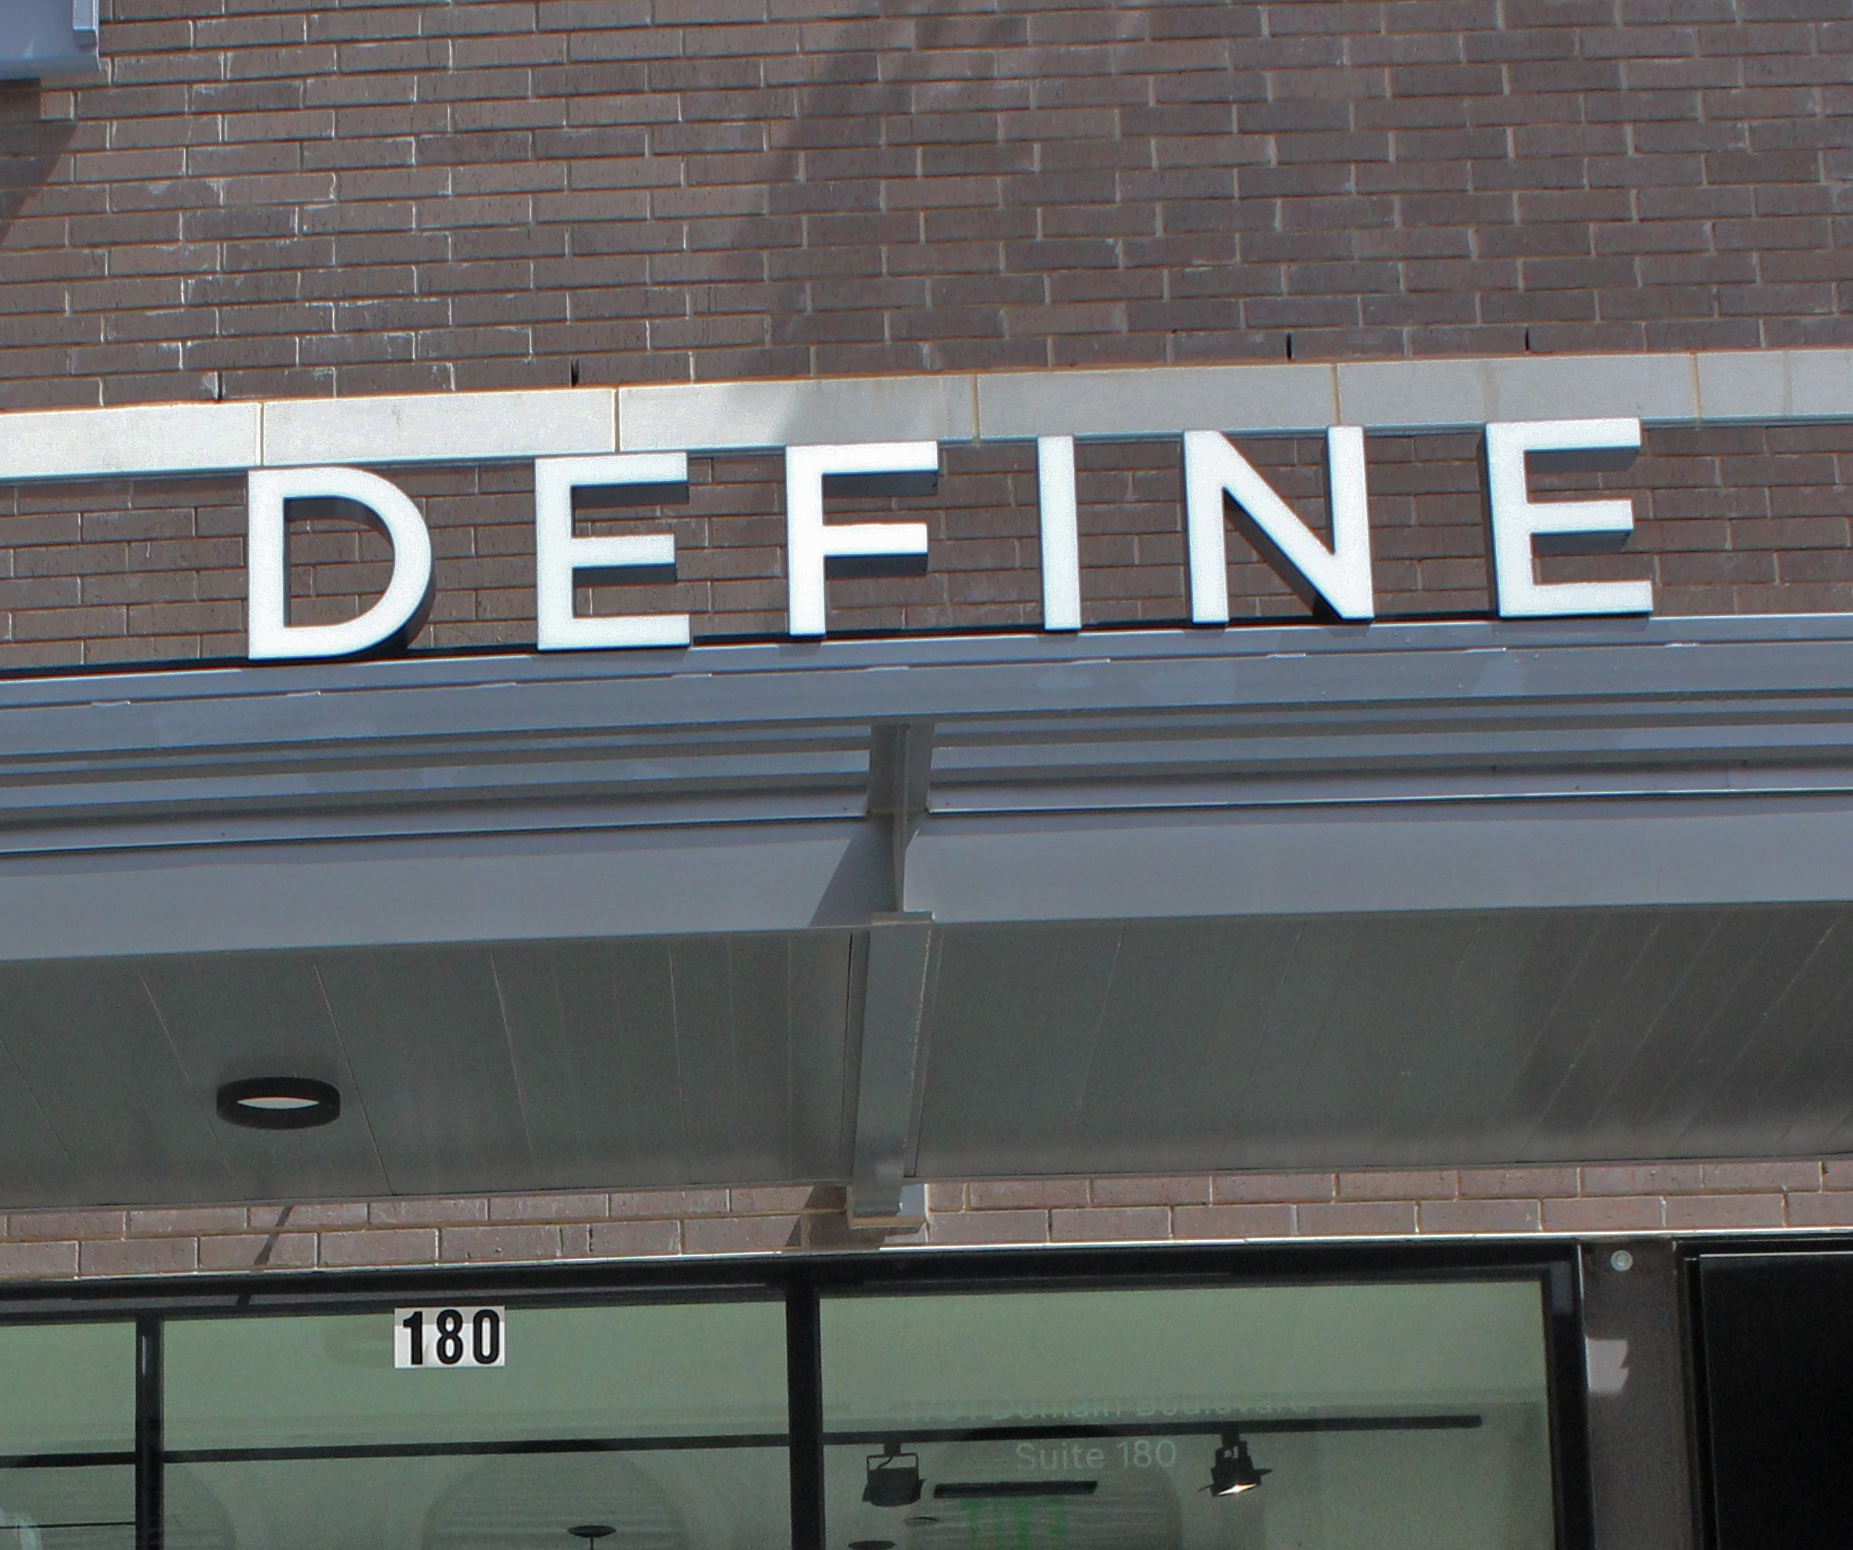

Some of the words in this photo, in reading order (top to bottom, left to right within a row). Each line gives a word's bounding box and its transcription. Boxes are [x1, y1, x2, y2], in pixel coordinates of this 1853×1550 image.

[248, 418, 1652, 660] DEFINE
[403, 1309, 500, 1365] 180
[1016, 1442, 1104, 1470] Suite
[1117, 1438, 1177, 1468] 180
